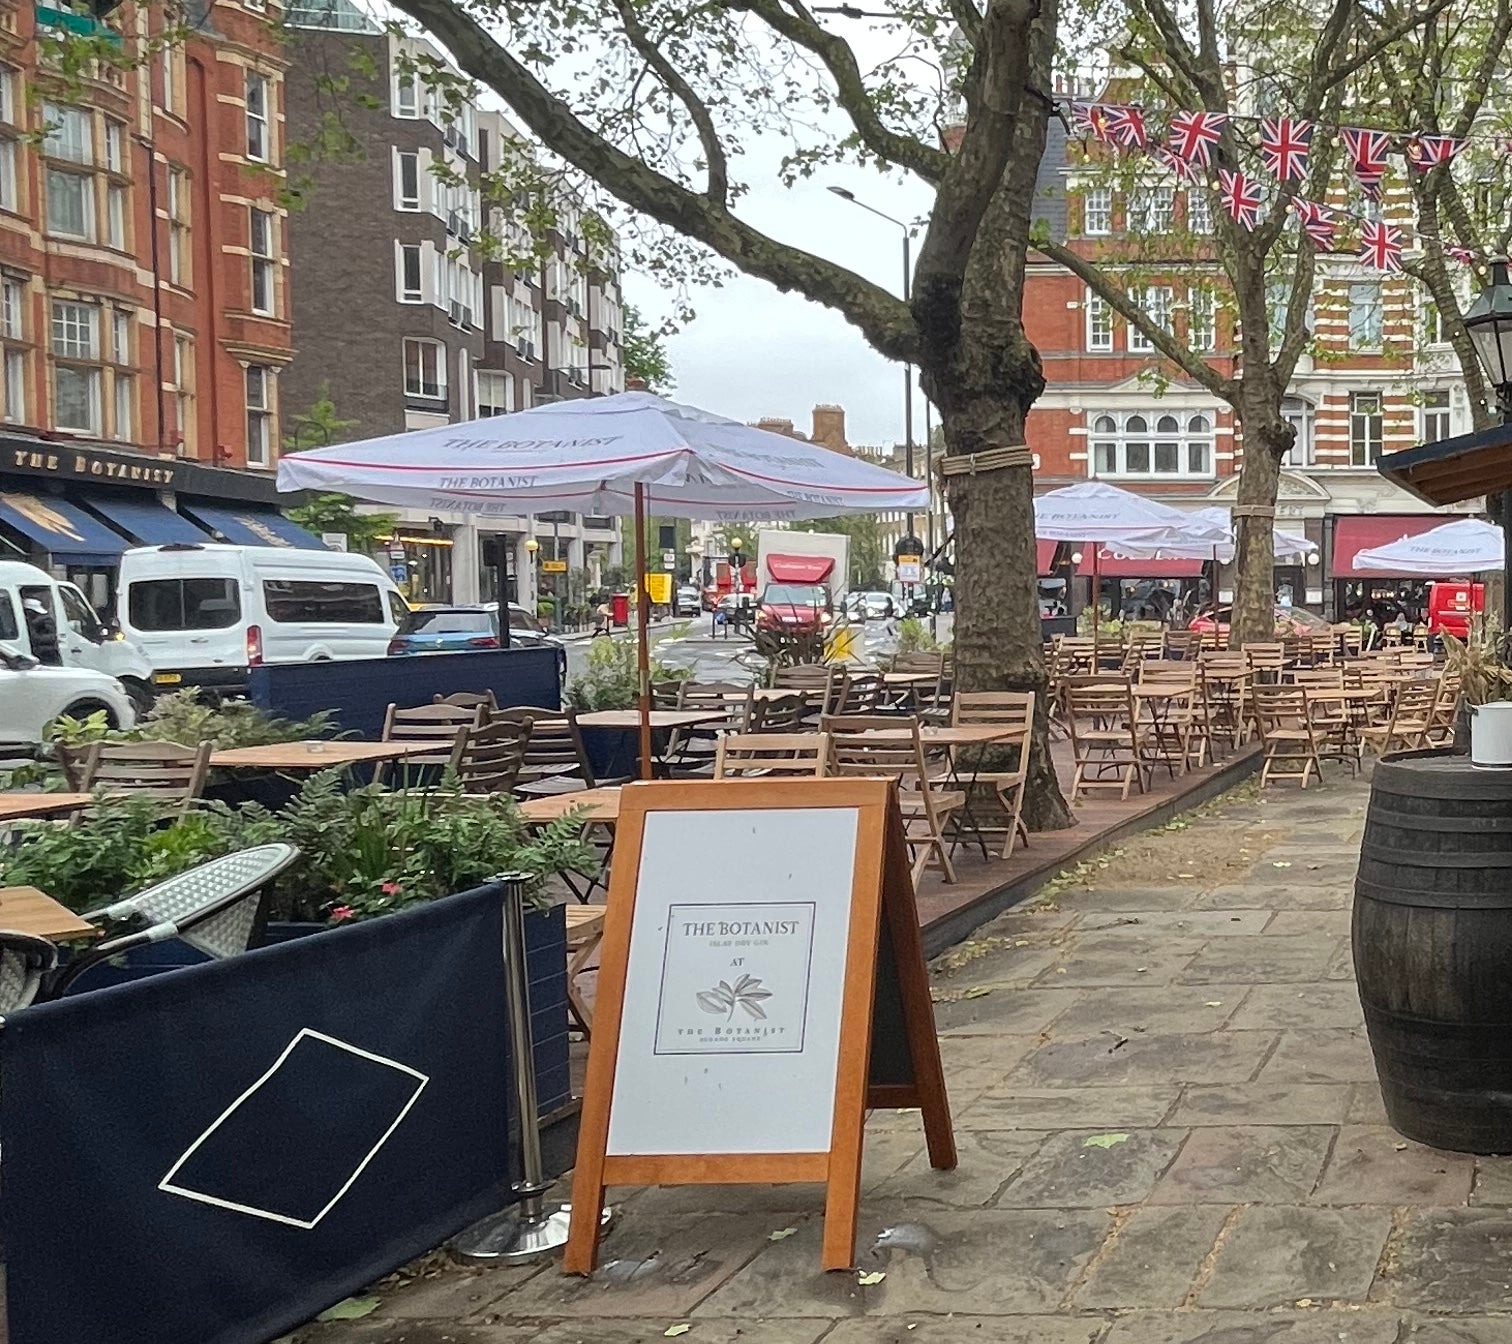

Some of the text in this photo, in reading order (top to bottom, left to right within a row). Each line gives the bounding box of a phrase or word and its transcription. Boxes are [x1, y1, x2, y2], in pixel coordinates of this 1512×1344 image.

[15, 450, 174, 484] THE BOTANIST
[440, 474, 539, 488] THE BOTANIST
[683, 920, 800, 936] THE BOTANIST
[729, 957, 745, 967] AT
[714, 1027, 786, 1036] BOTANIST
